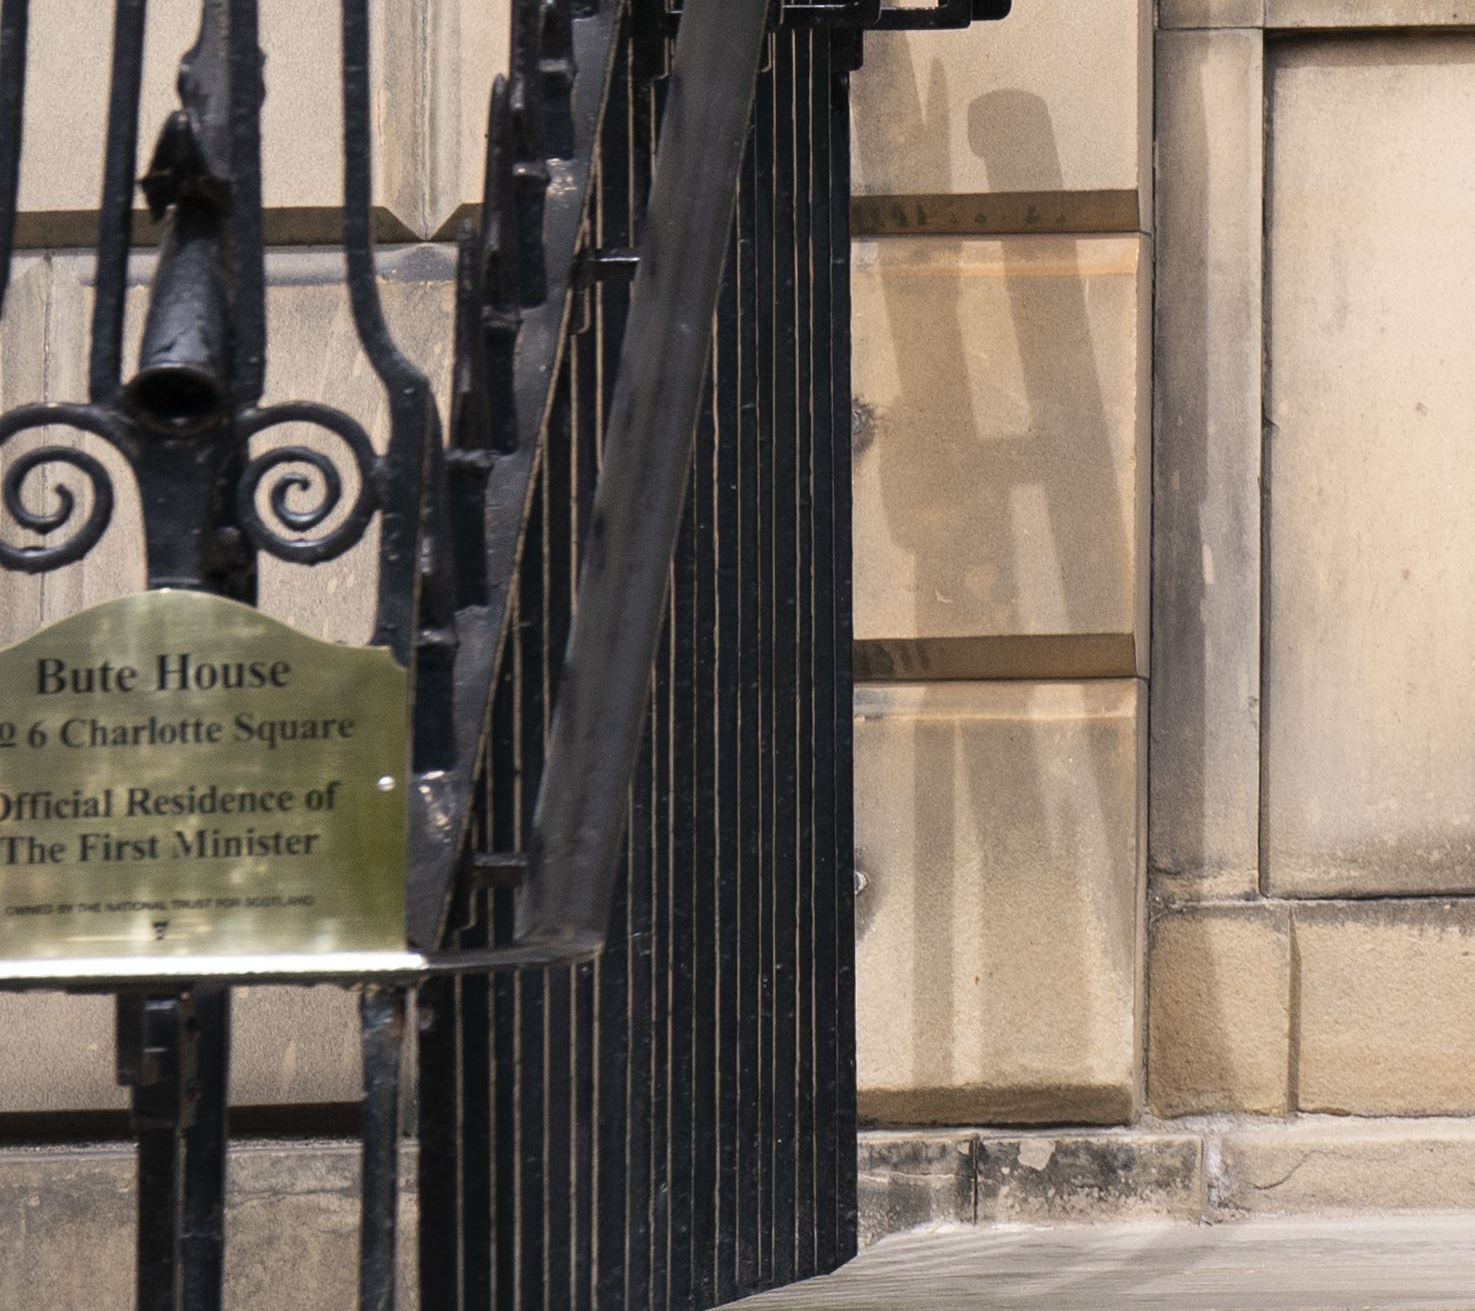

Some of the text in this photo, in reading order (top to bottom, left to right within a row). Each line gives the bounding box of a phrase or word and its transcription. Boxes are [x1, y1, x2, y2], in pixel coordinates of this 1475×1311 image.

[35, 654, 292, 695] Bute House
[27, 722, 47, 749] 6
[58, 716, 222, 750] Charlotte
[234, 711, 356, 750] Square
[128, 785, 296, 816] Residence
[305, 781, 342, 810] of
[1, 828, 319, 865] The First Minister
